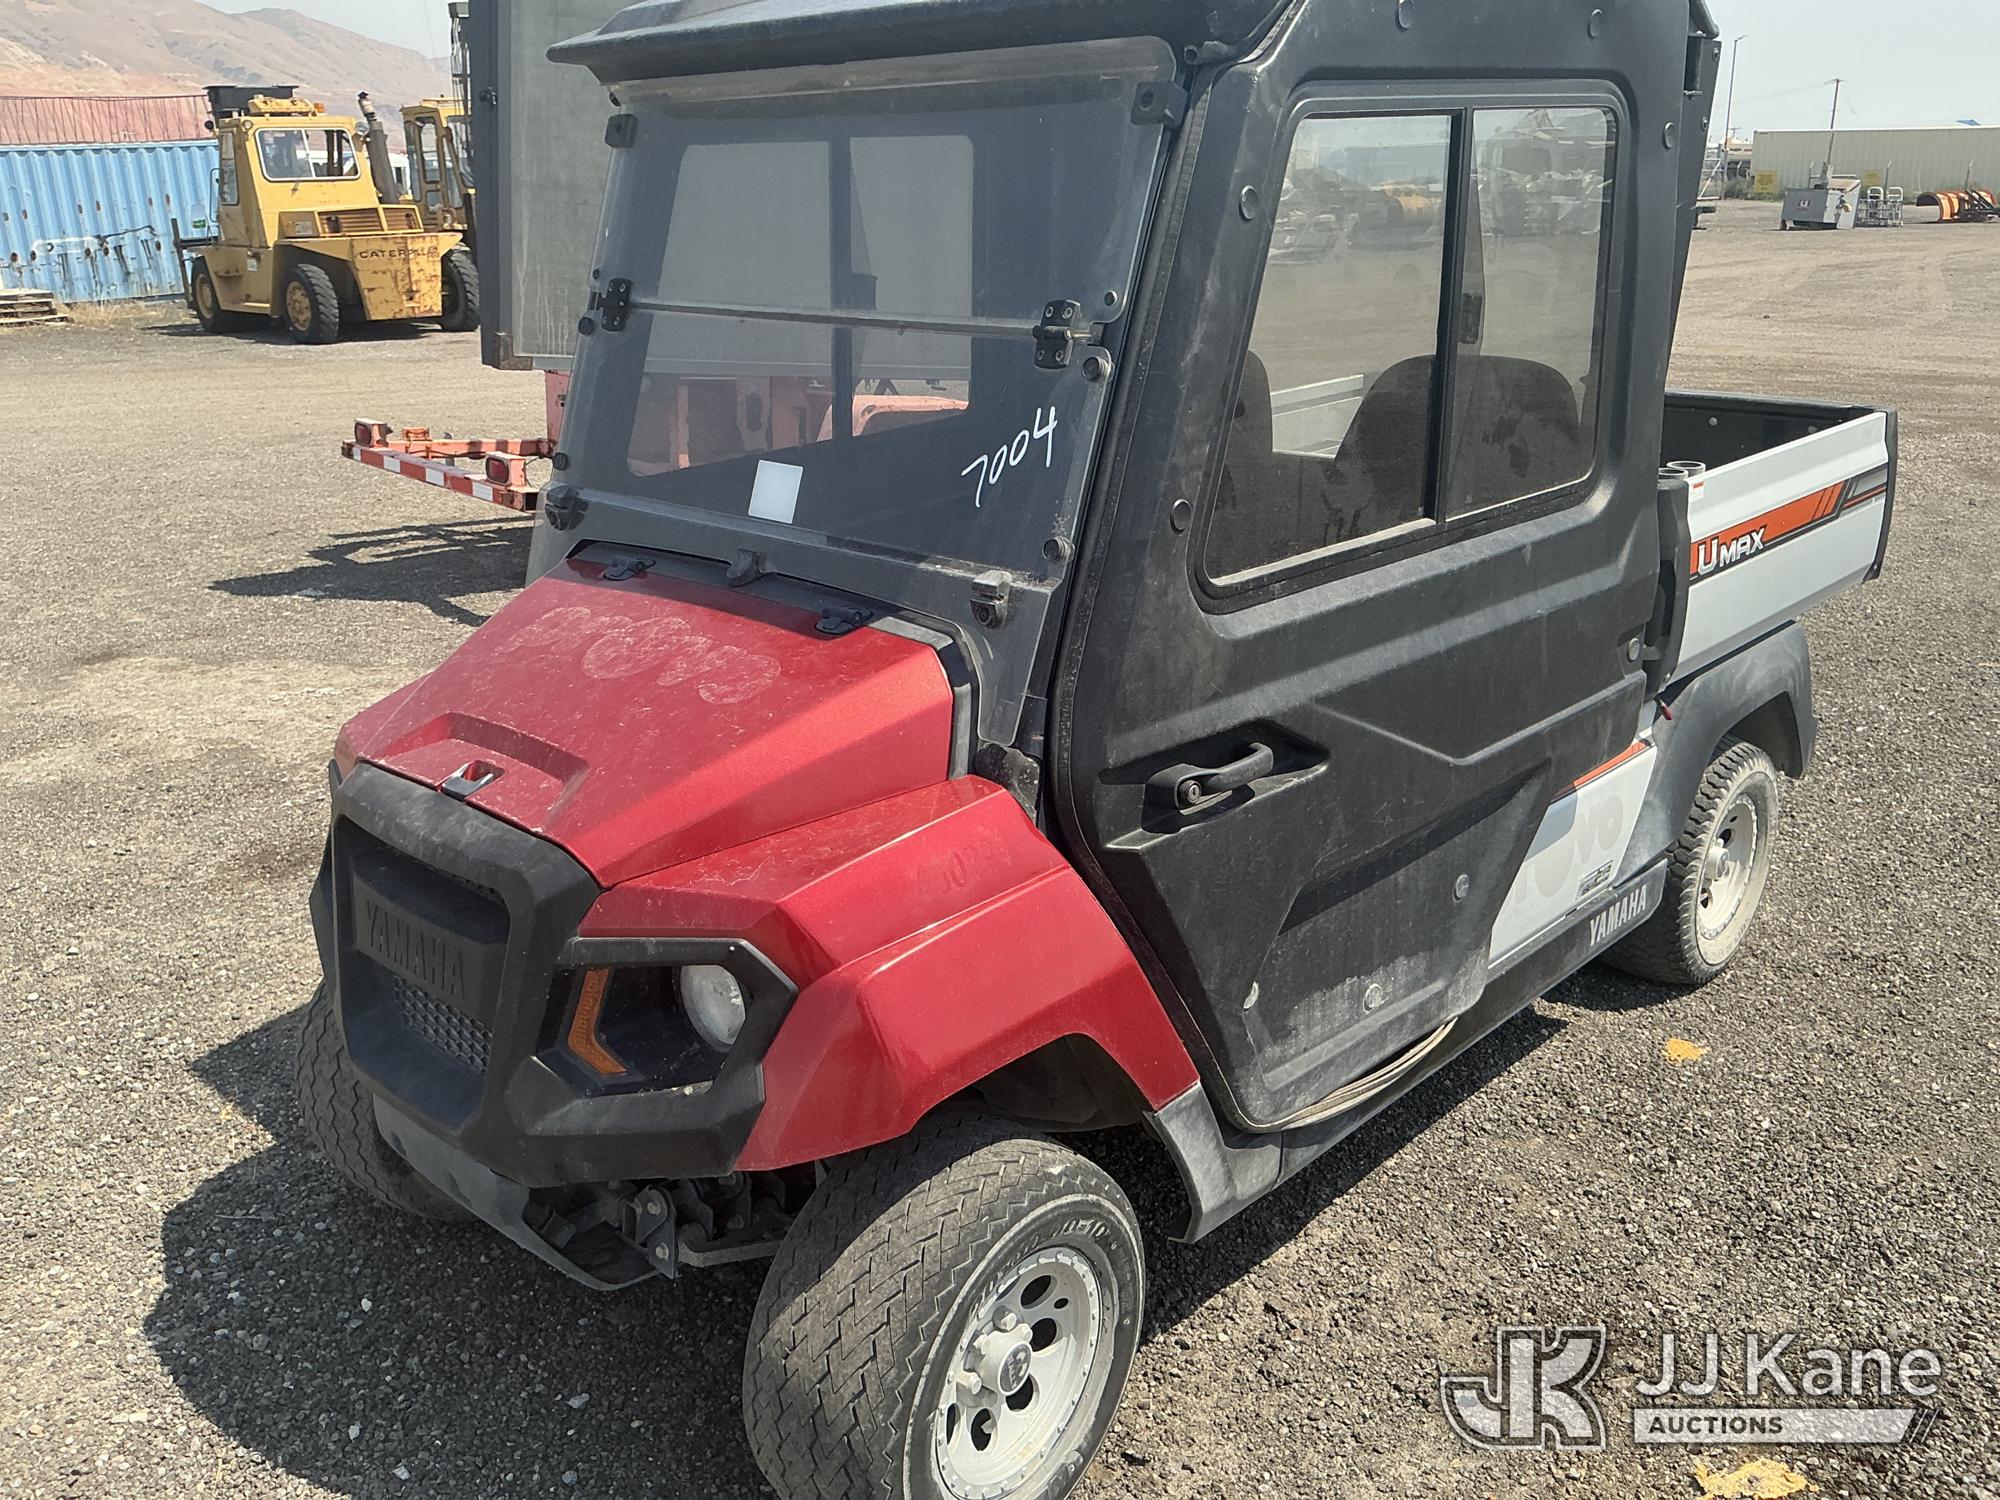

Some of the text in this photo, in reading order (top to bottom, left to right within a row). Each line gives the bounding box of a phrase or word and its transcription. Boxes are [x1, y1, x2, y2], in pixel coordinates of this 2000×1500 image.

[961, 406, 1058, 508] 7004
[364, 897, 466, 1001] YAMAHA
[1590, 884, 1647, 946] YAMAHA
